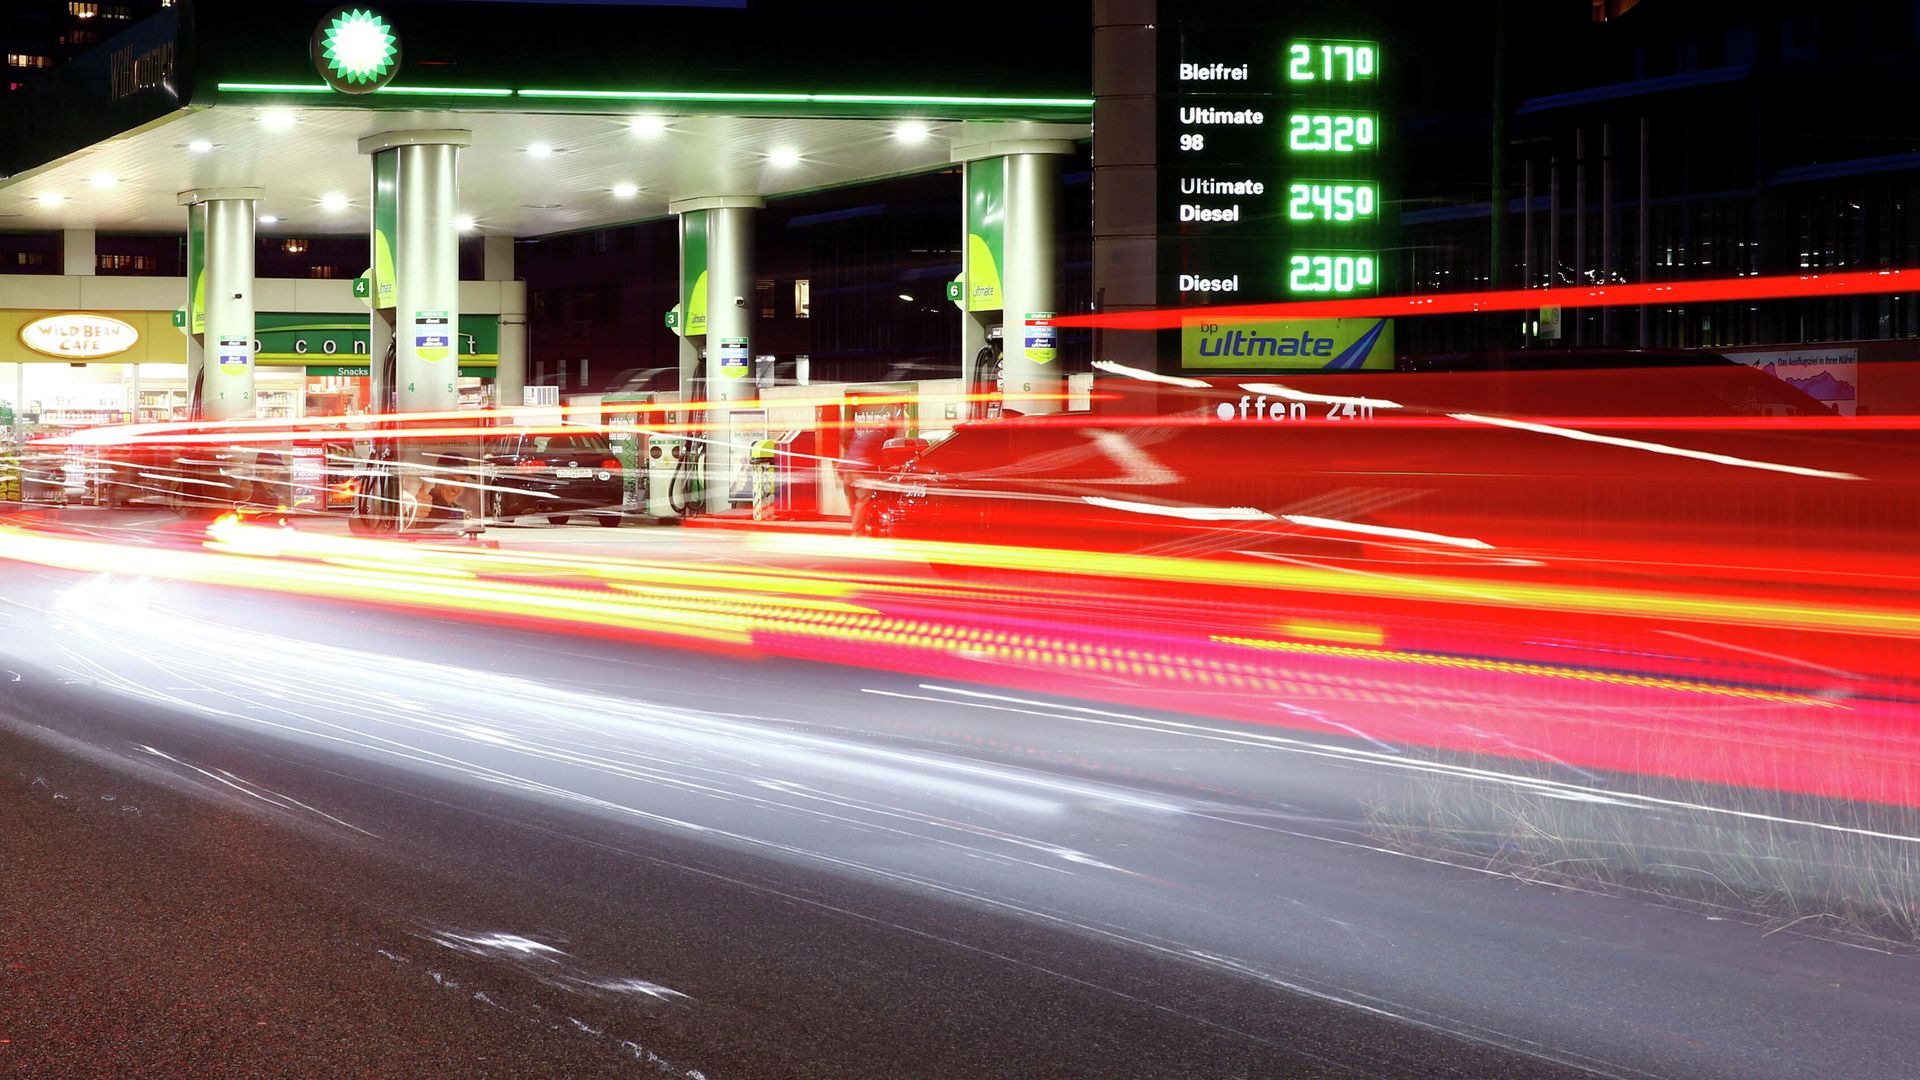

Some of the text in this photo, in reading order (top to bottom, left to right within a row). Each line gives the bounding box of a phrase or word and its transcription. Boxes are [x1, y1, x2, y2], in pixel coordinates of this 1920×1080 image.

[1180, 64, 1248, 81] Bleifrei
[1180, 108, 1264, 126] Ultimate
[1180, 135, 1204, 152] 98
[1181, 178, 1264, 195] Ultimate
[1180, 205, 1239, 222] Diesel
[356, 282, 366, 293] 4
[1180, 275, 1239, 292] Diesel
[950, 284, 958, 296] 6
[175, 313, 182, 323] 1
[668, 314, 675, 324] 3
[83, 325, 121, 338] BEAN
[1201, 321, 1218, 335] bp
[1199, 330, 1334, 357] ultimate
[1777, 358, 1788, 366] Das
[1788, 357, 1818, 367] Ausflugsziel
[1825, 357, 1838, 365] Ihrer
[337, 367, 369, 376] Snacks
[407, 382, 416, 393] 4
[447, 383, 454, 393] 5
[1023, 382, 1031, 391] 6
[243, 391, 249, 400] 2
[720, 393, 727, 401] 3
[1326, 396, 1374, 422] 24h
